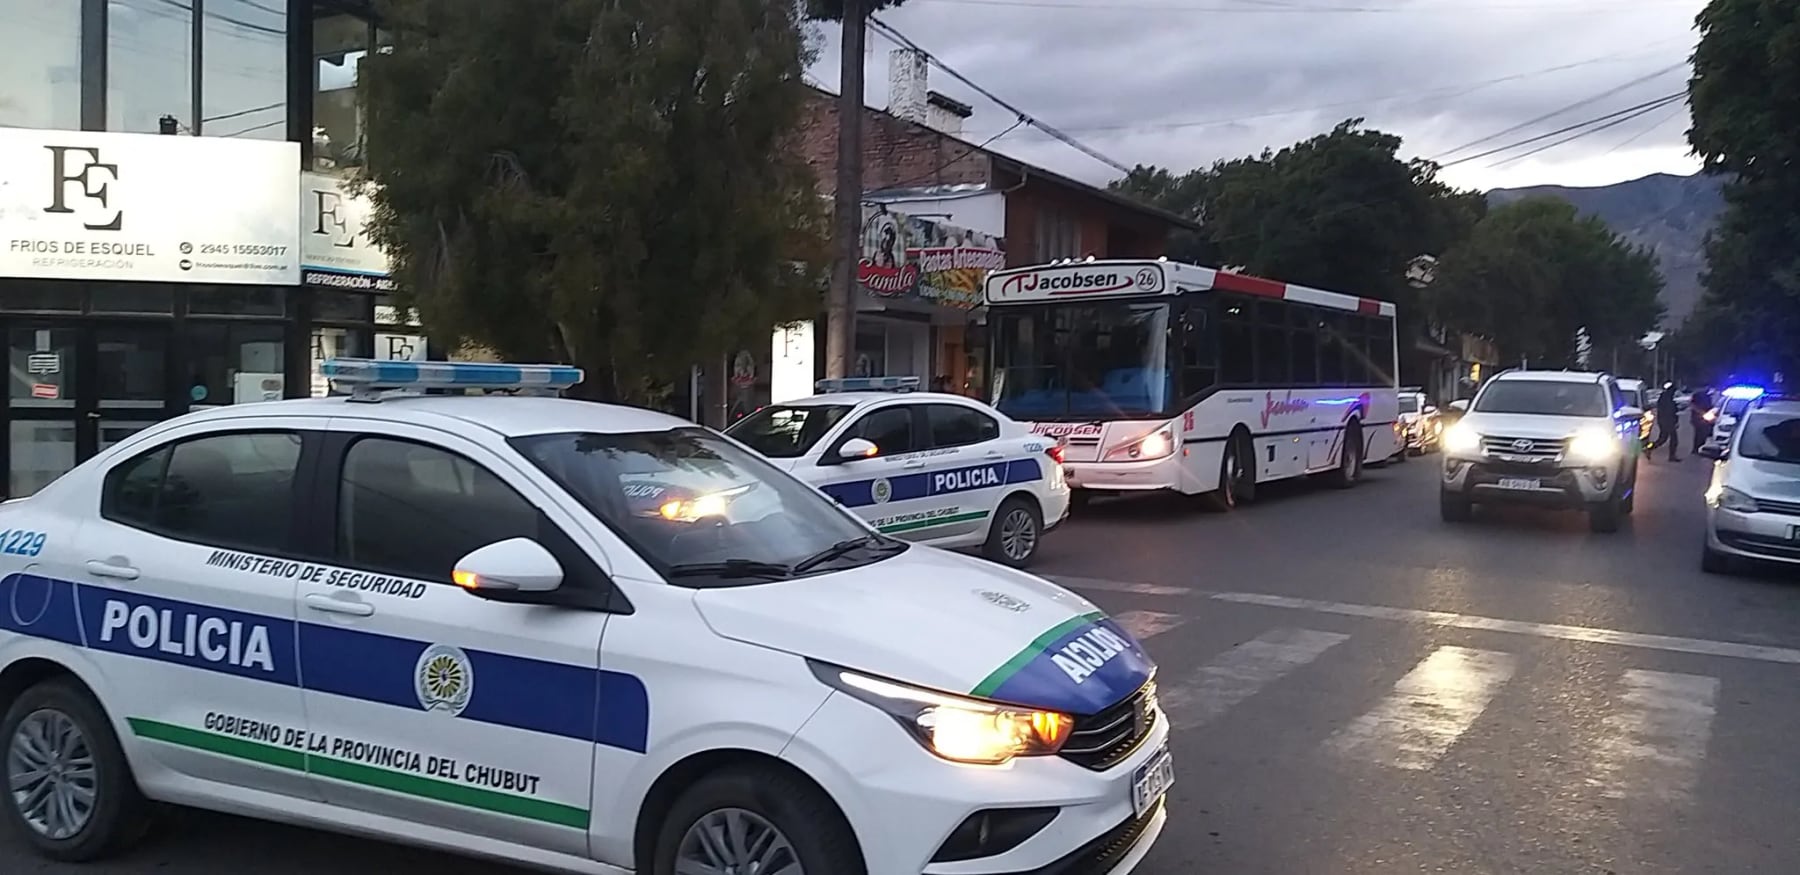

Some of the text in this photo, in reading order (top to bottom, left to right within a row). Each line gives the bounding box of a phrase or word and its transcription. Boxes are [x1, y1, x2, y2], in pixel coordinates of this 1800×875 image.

[11, 239, 155, 256] FRIOS DE ESQUEL
[201, 244, 230, 254] 2945
[920, 250, 953, 273] Pastas
[858, 257, 917, 294] Camila
[1139, 273, 1155, 286] 26
[935, 467, 999, 492] POLICIA
[0, 529, 47, 557] 1229
[206, 550, 427, 600] MINISTERIO DE SEGURIDAD
[100, 599, 274, 672] POLICIA
[204, 711, 540, 795] GOBIERNO DE LA PROVINCIA DEL CHUBUT
